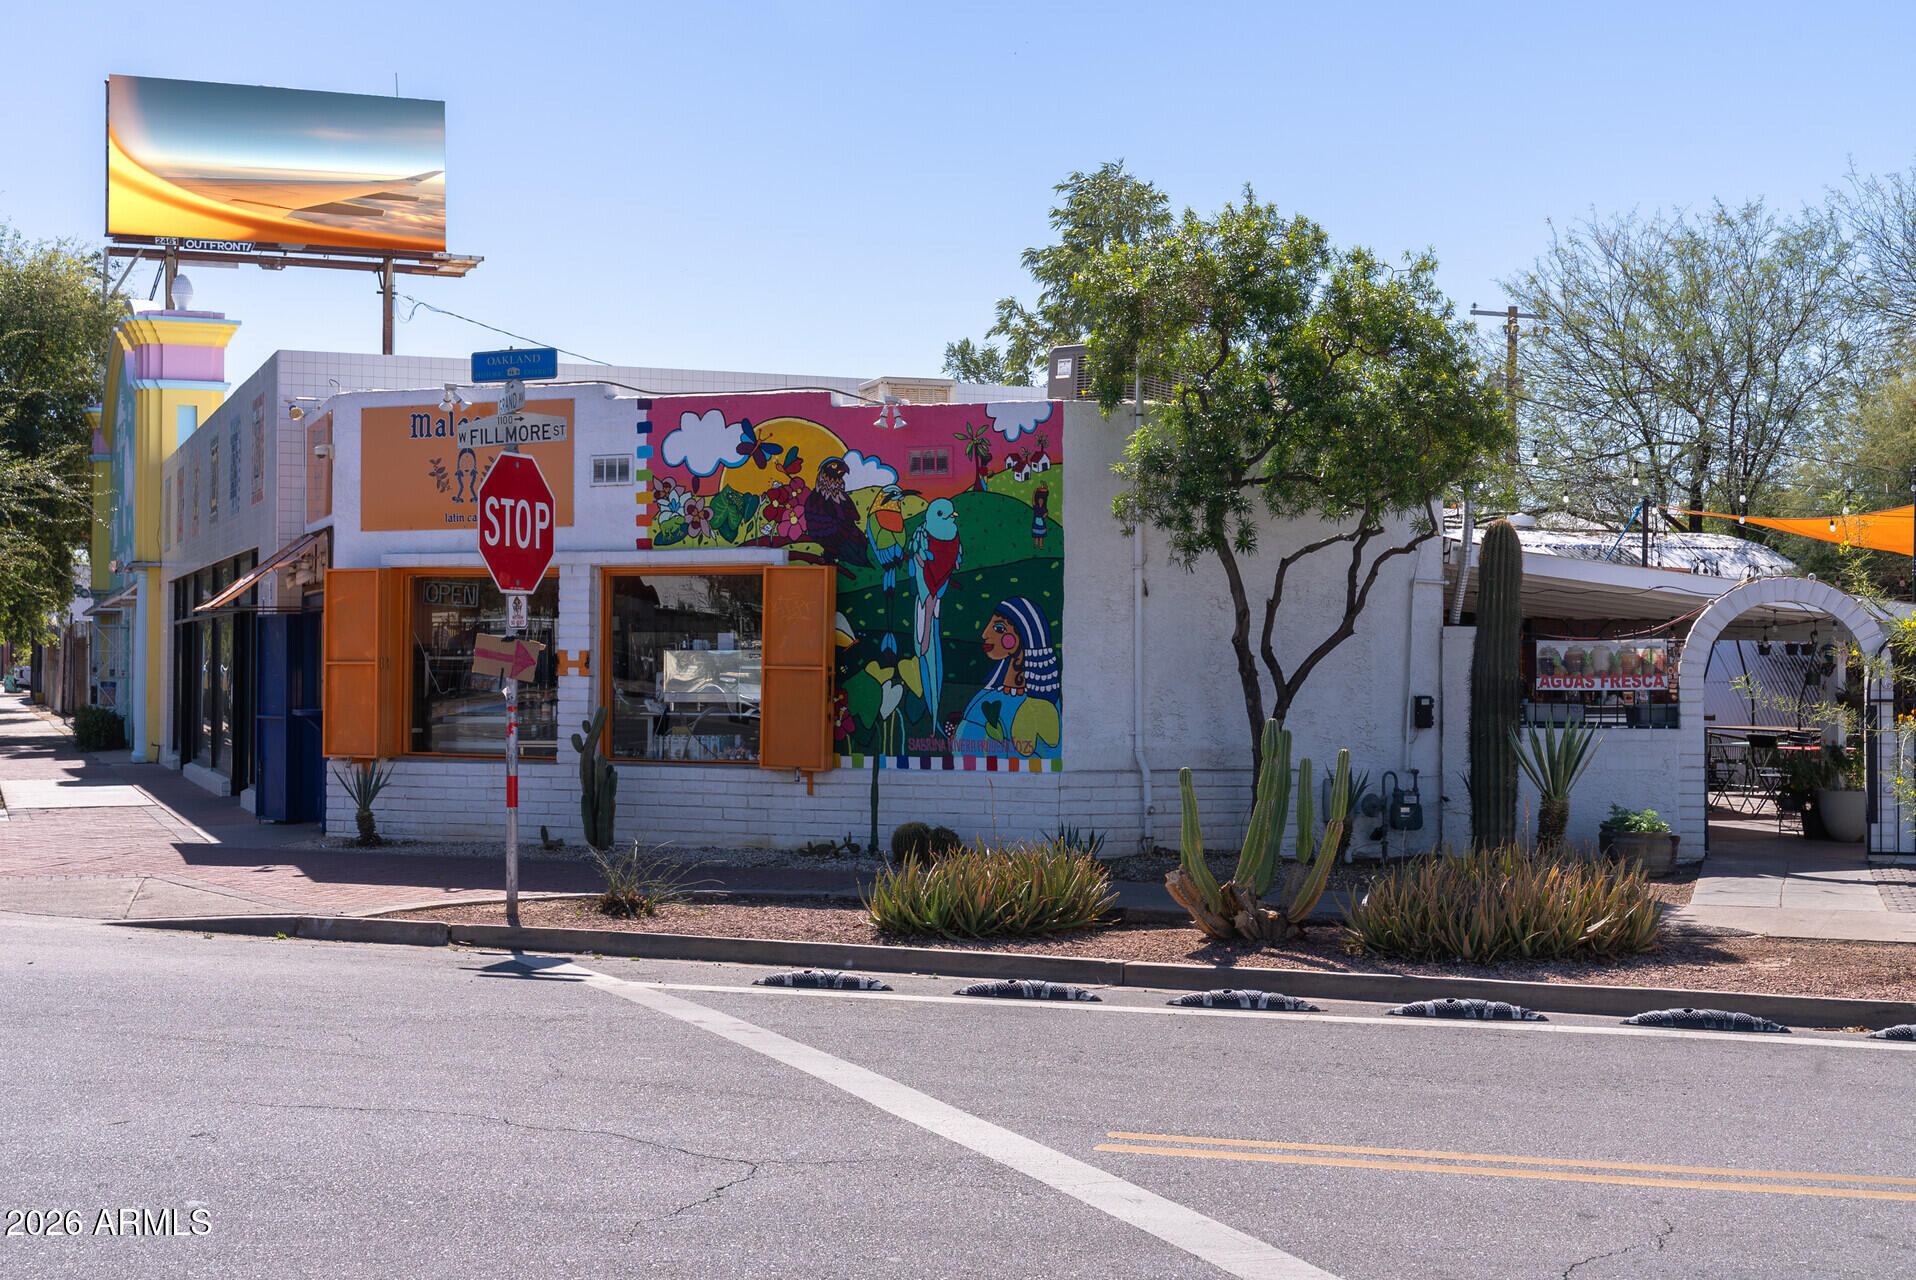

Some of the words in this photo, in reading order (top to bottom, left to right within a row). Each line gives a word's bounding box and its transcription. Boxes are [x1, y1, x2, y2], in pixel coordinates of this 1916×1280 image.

[487, 354, 542, 366] OAKLAND
[497, 415, 513, 425] 1100
[458, 432, 467, 443] W
[470, 424, 552, 446] FILLMORE
[553, 425, 566, 437] ST
[445, 511, 465, 523] latin
[484, 496, 550, 550] STOP
[425, 582, 476, 605] OPEN
[1539, 673, 1596, 689] AGUAS
[1600, 673, 1665, 689] FRESCA
[908, 734, 946, 752] SABRINA
[948, 735, 976, 753] RIVERA
